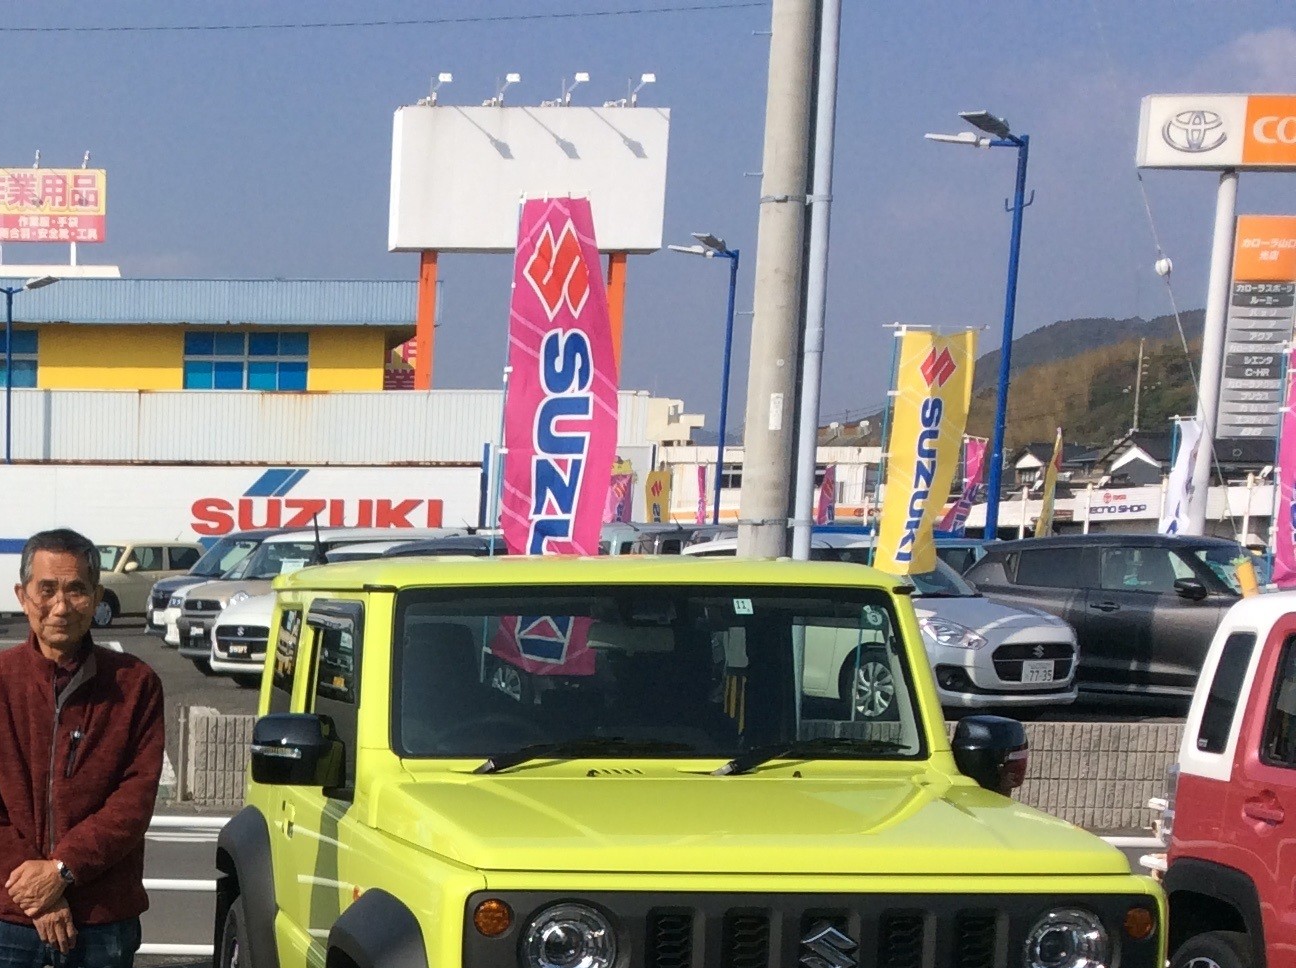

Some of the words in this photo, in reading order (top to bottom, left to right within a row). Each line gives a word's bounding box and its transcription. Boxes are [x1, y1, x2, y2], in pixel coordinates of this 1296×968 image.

[1245, 368, 1270, 377] C-HR
[894, 397, 944, 562] SUZUKI
[190, 497, 444, 536] SUZUKI
